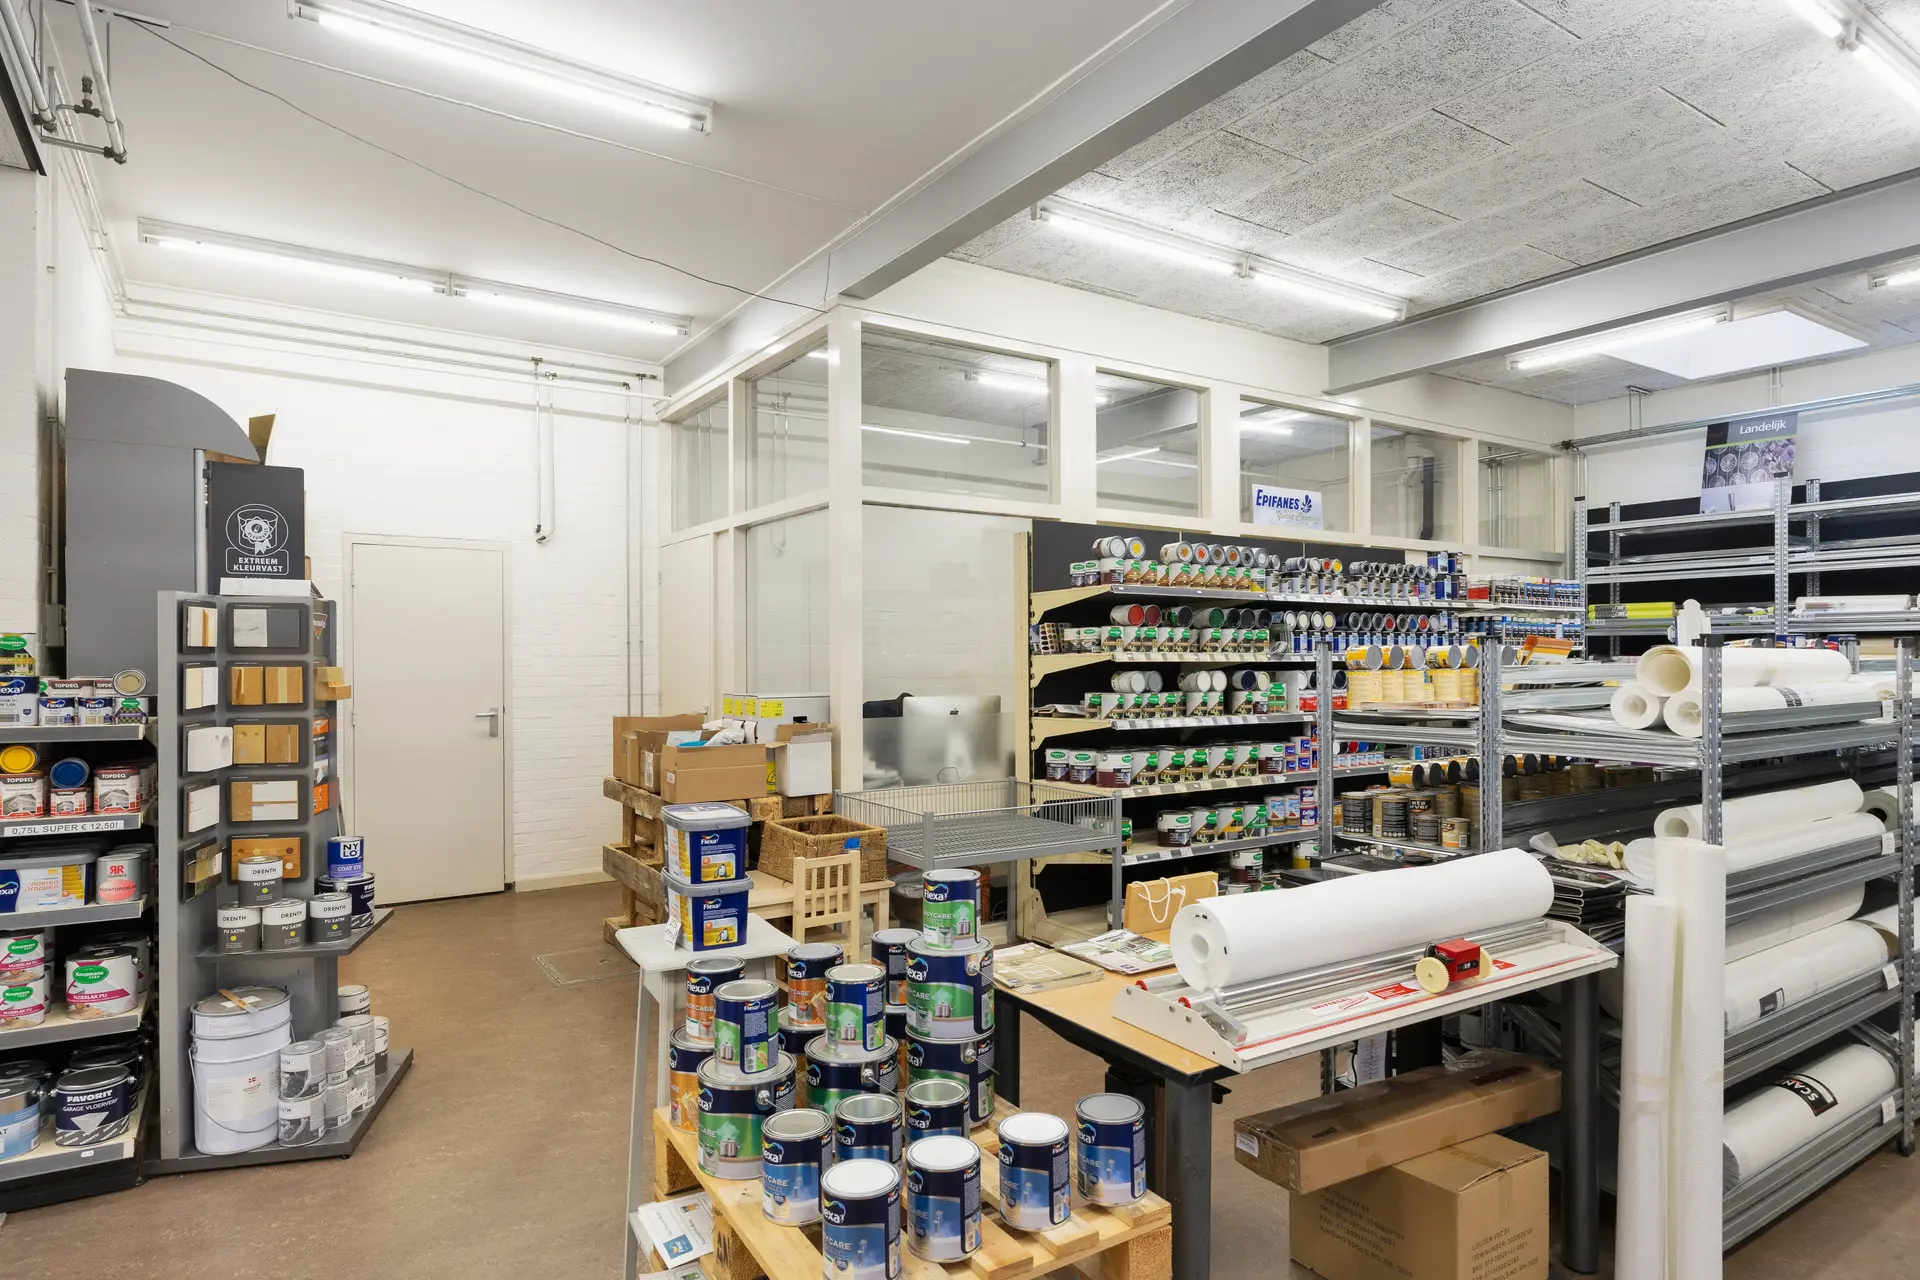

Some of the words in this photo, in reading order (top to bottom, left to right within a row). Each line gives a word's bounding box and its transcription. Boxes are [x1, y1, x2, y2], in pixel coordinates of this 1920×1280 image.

[1740, 420, 1786, 434] Landelijk
[1256, 489, 1300, 510] EPIFANES
[233, 564, 284, 572] KLEURVAST
[42, 824, 78, 833] SUPER
[924, 890, 946, 900] Flexa
[280, 910, 303, 918] DRENTH
[687, 981, 710, 994] Flexa
[67, 1090, 113, 1102] FAVORIT
[86, 1098, 118, 1110] VLOERVERF
[823, 1208, 844, 1223] exa
